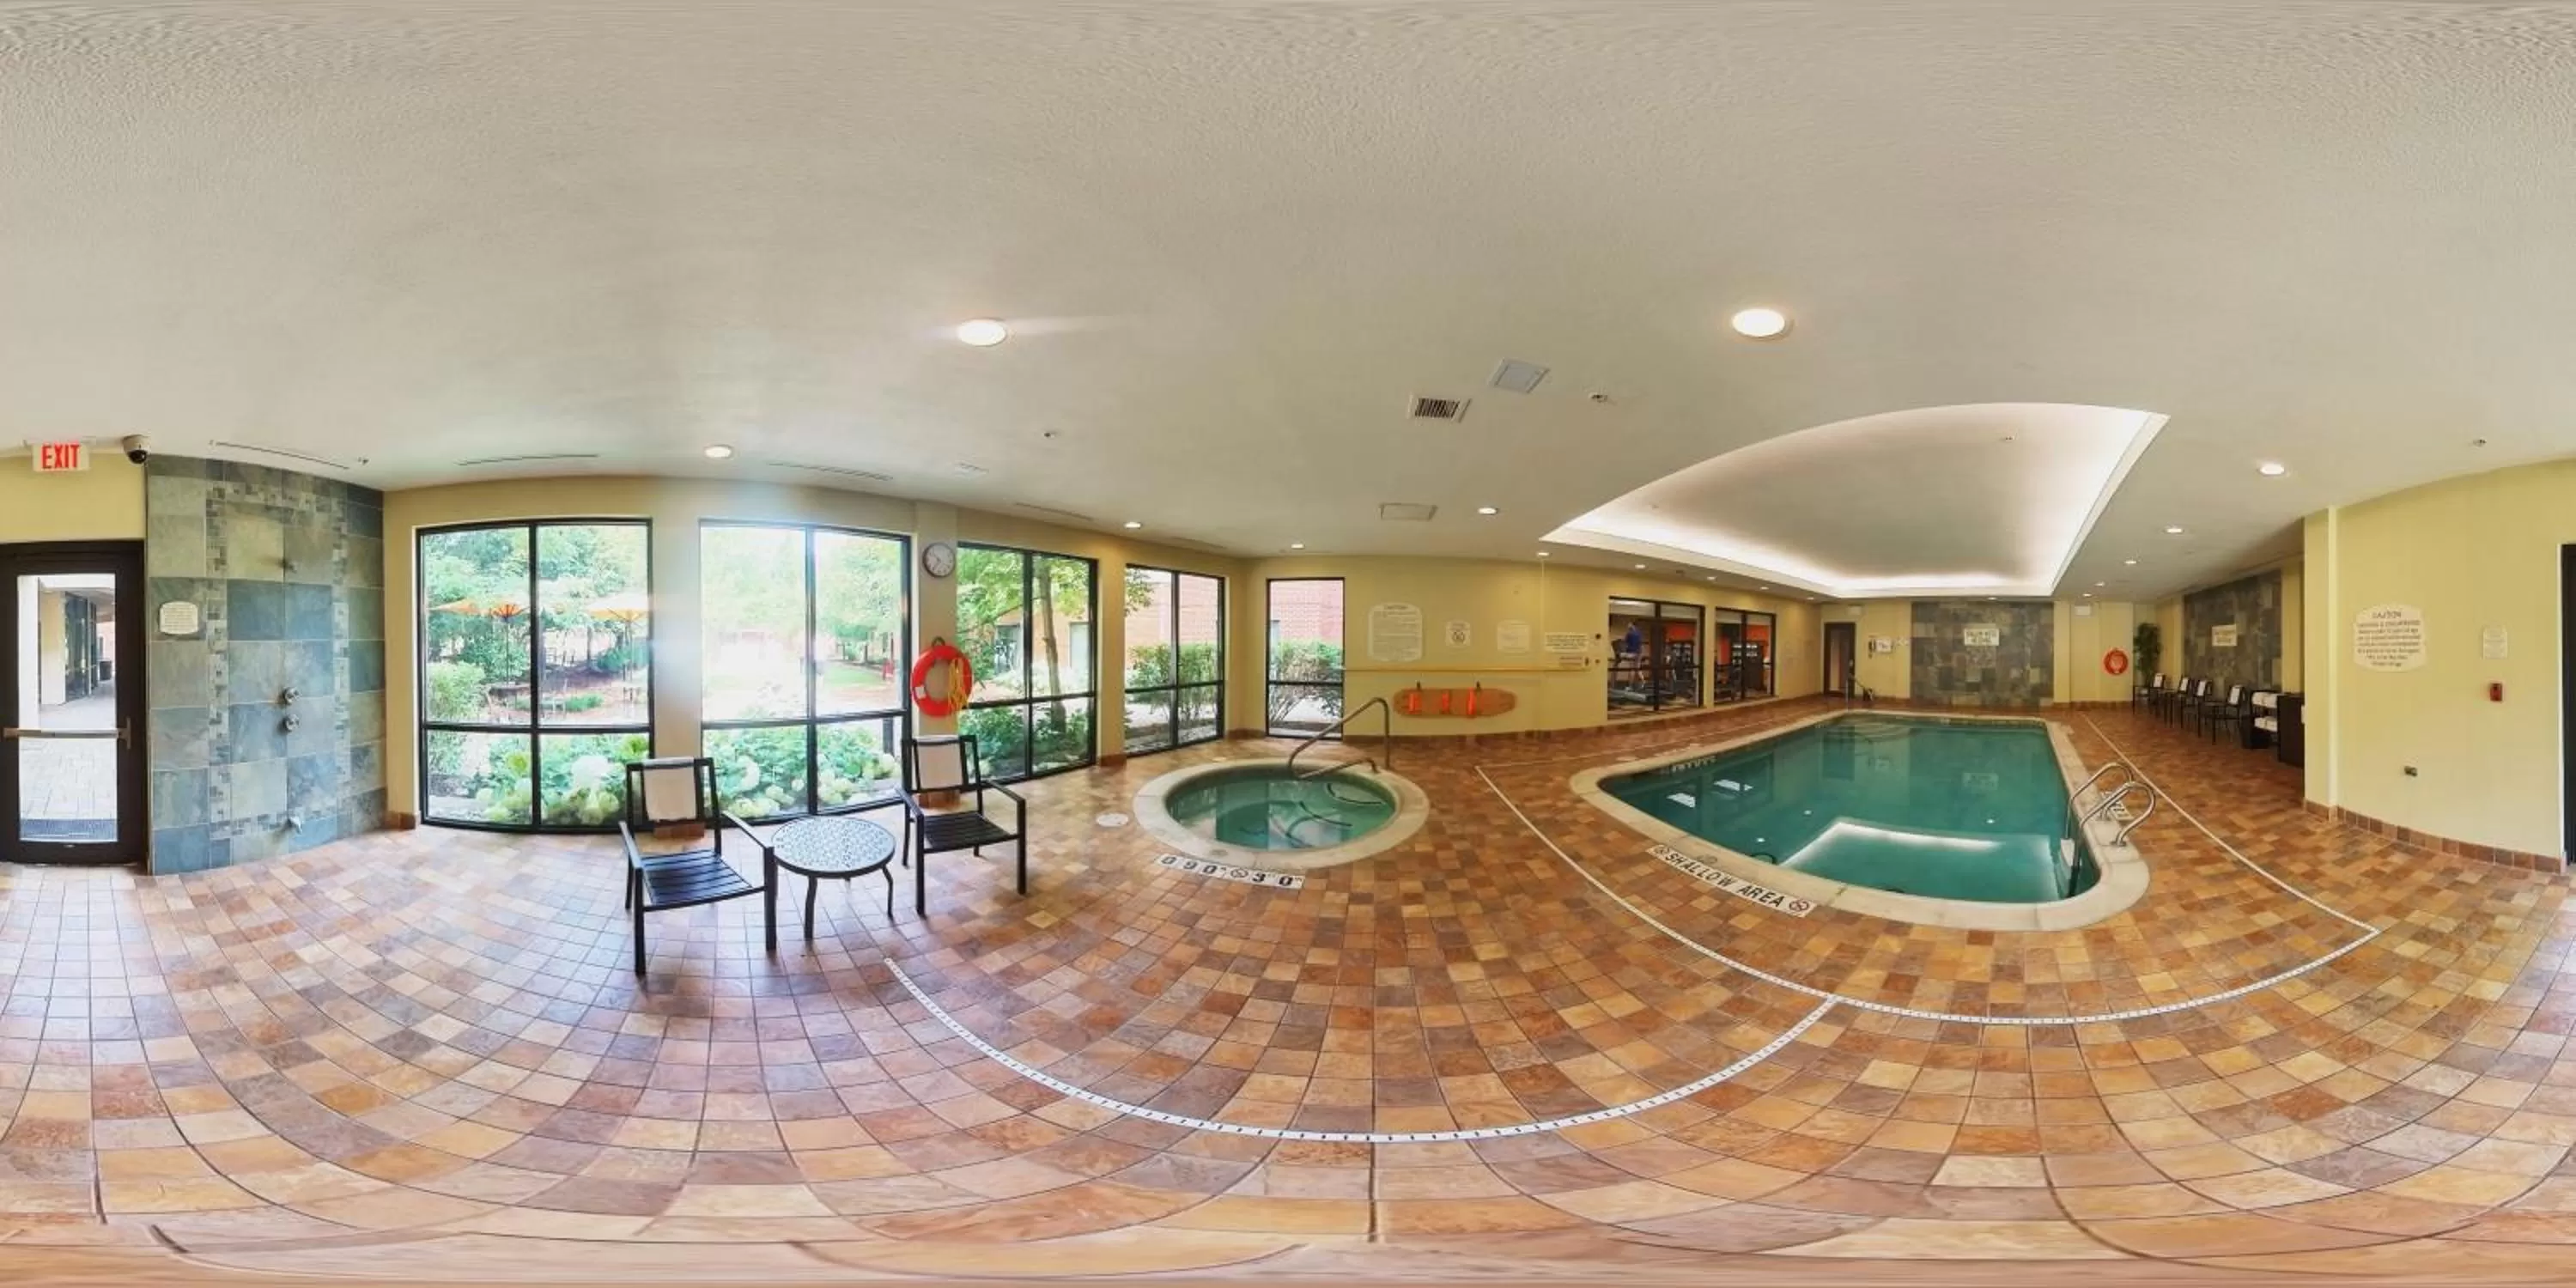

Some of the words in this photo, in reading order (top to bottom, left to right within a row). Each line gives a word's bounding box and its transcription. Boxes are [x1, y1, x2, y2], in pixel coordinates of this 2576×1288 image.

[41, 443, 80, 469] EXIT
[1665, 852, 1737, 887] SHALLOW
[1737, 884, 1784, 908] AREA
